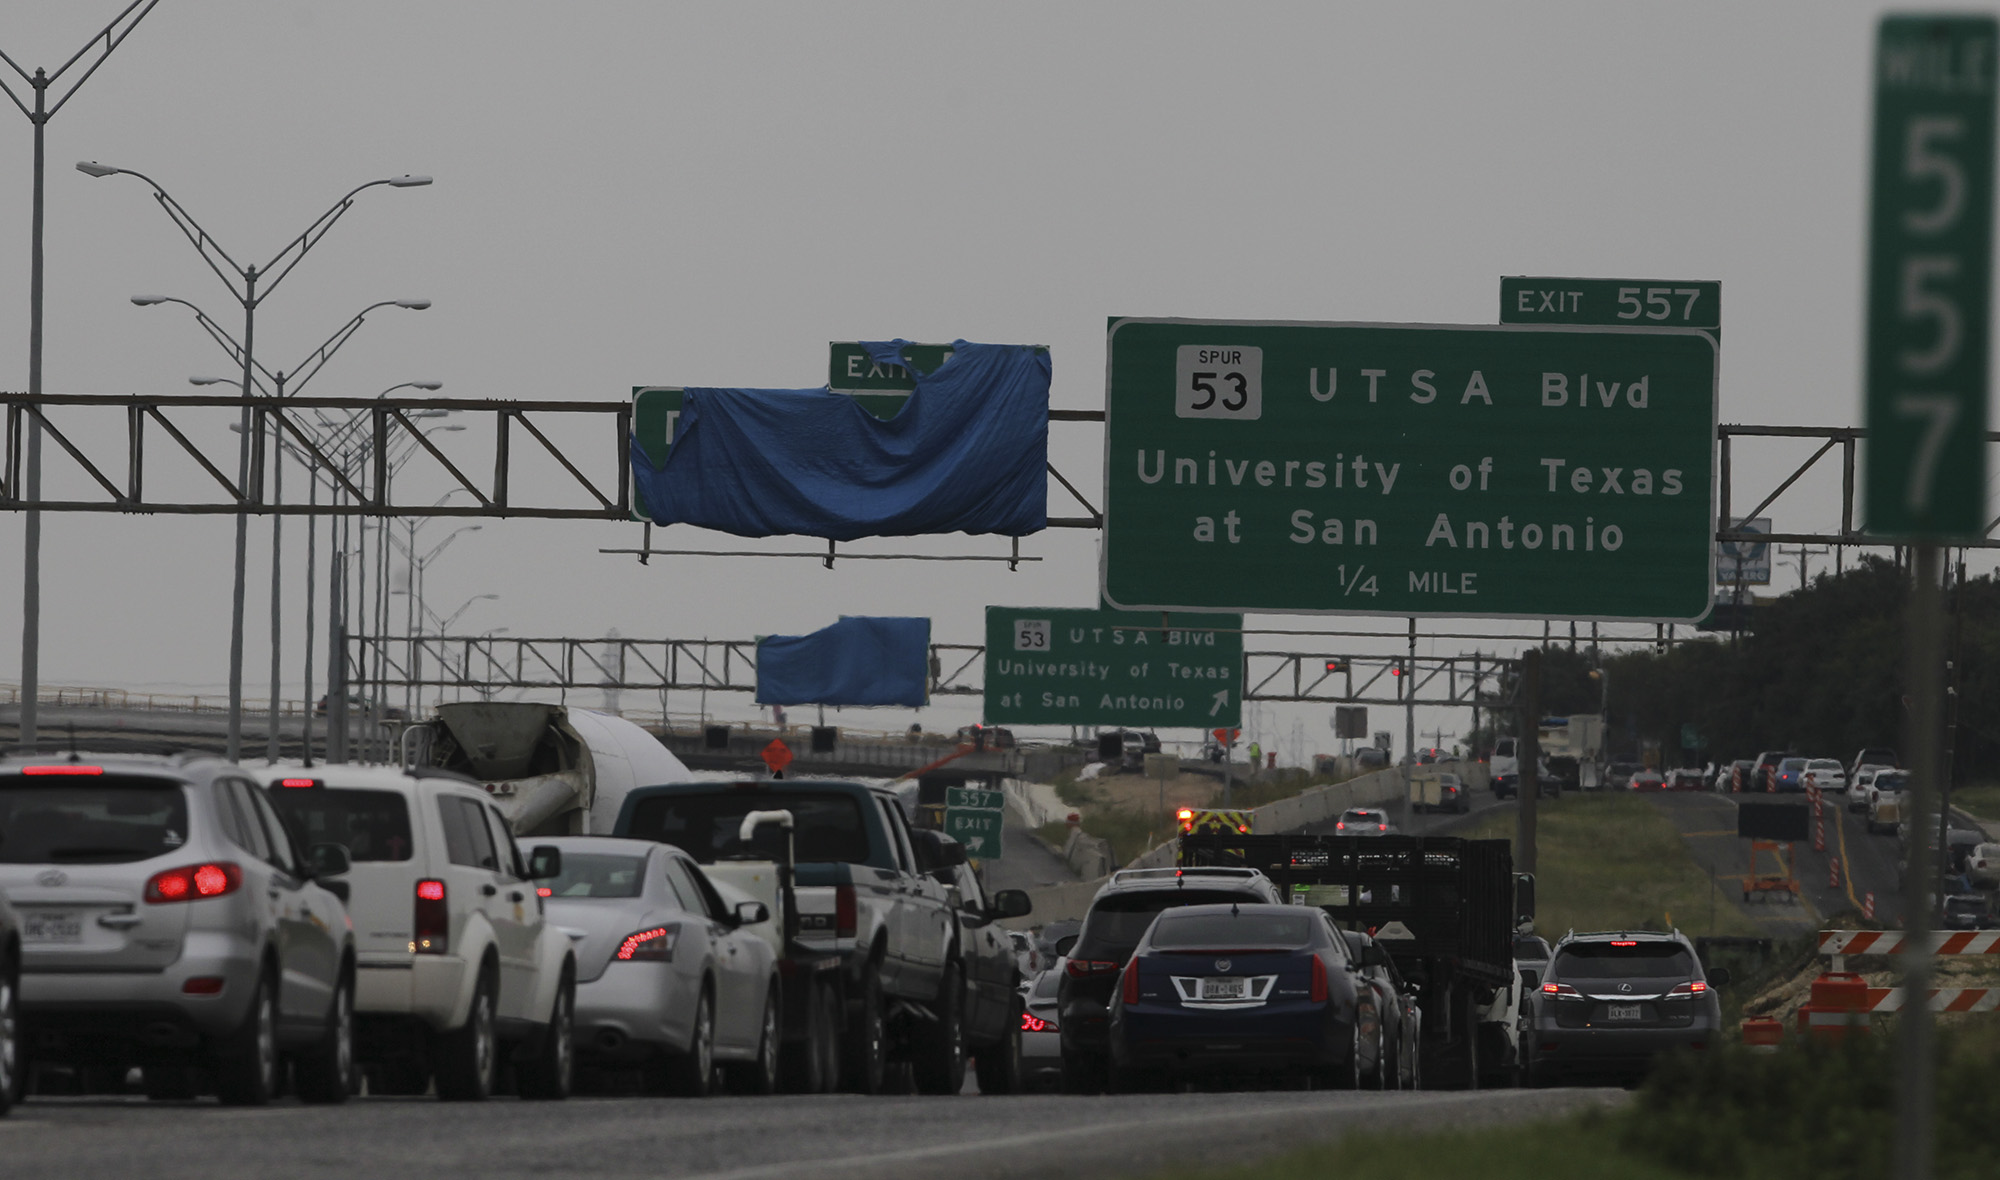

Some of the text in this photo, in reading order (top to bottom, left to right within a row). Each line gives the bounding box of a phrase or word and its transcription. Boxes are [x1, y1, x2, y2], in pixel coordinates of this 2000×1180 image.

[1518, 287, 1702, 321] EXIT 557
[1198, 349, 1242, 365] SPUR
[1190, 371, 1248, 412] 53
[1541, 372, 1649, 409] Blvd
[1137, 448, 1683, 496] University of Texas
[1193, 508, 1624, 552] at San Antonio
[1337, 564, 1478, 597] 1/4 MILE
[1720, 570, 1766, 581] VAERO
[1020, 630, 1045, 648] 53
[1168, 630, 1215, 646] Blvd
[998, 659, 1230, 680] University of Texas
[1000, 691, 1185, 711] at San Antonio
[960, 791, 991, 807] 557
[954, 816, 992, 831] EXIT
